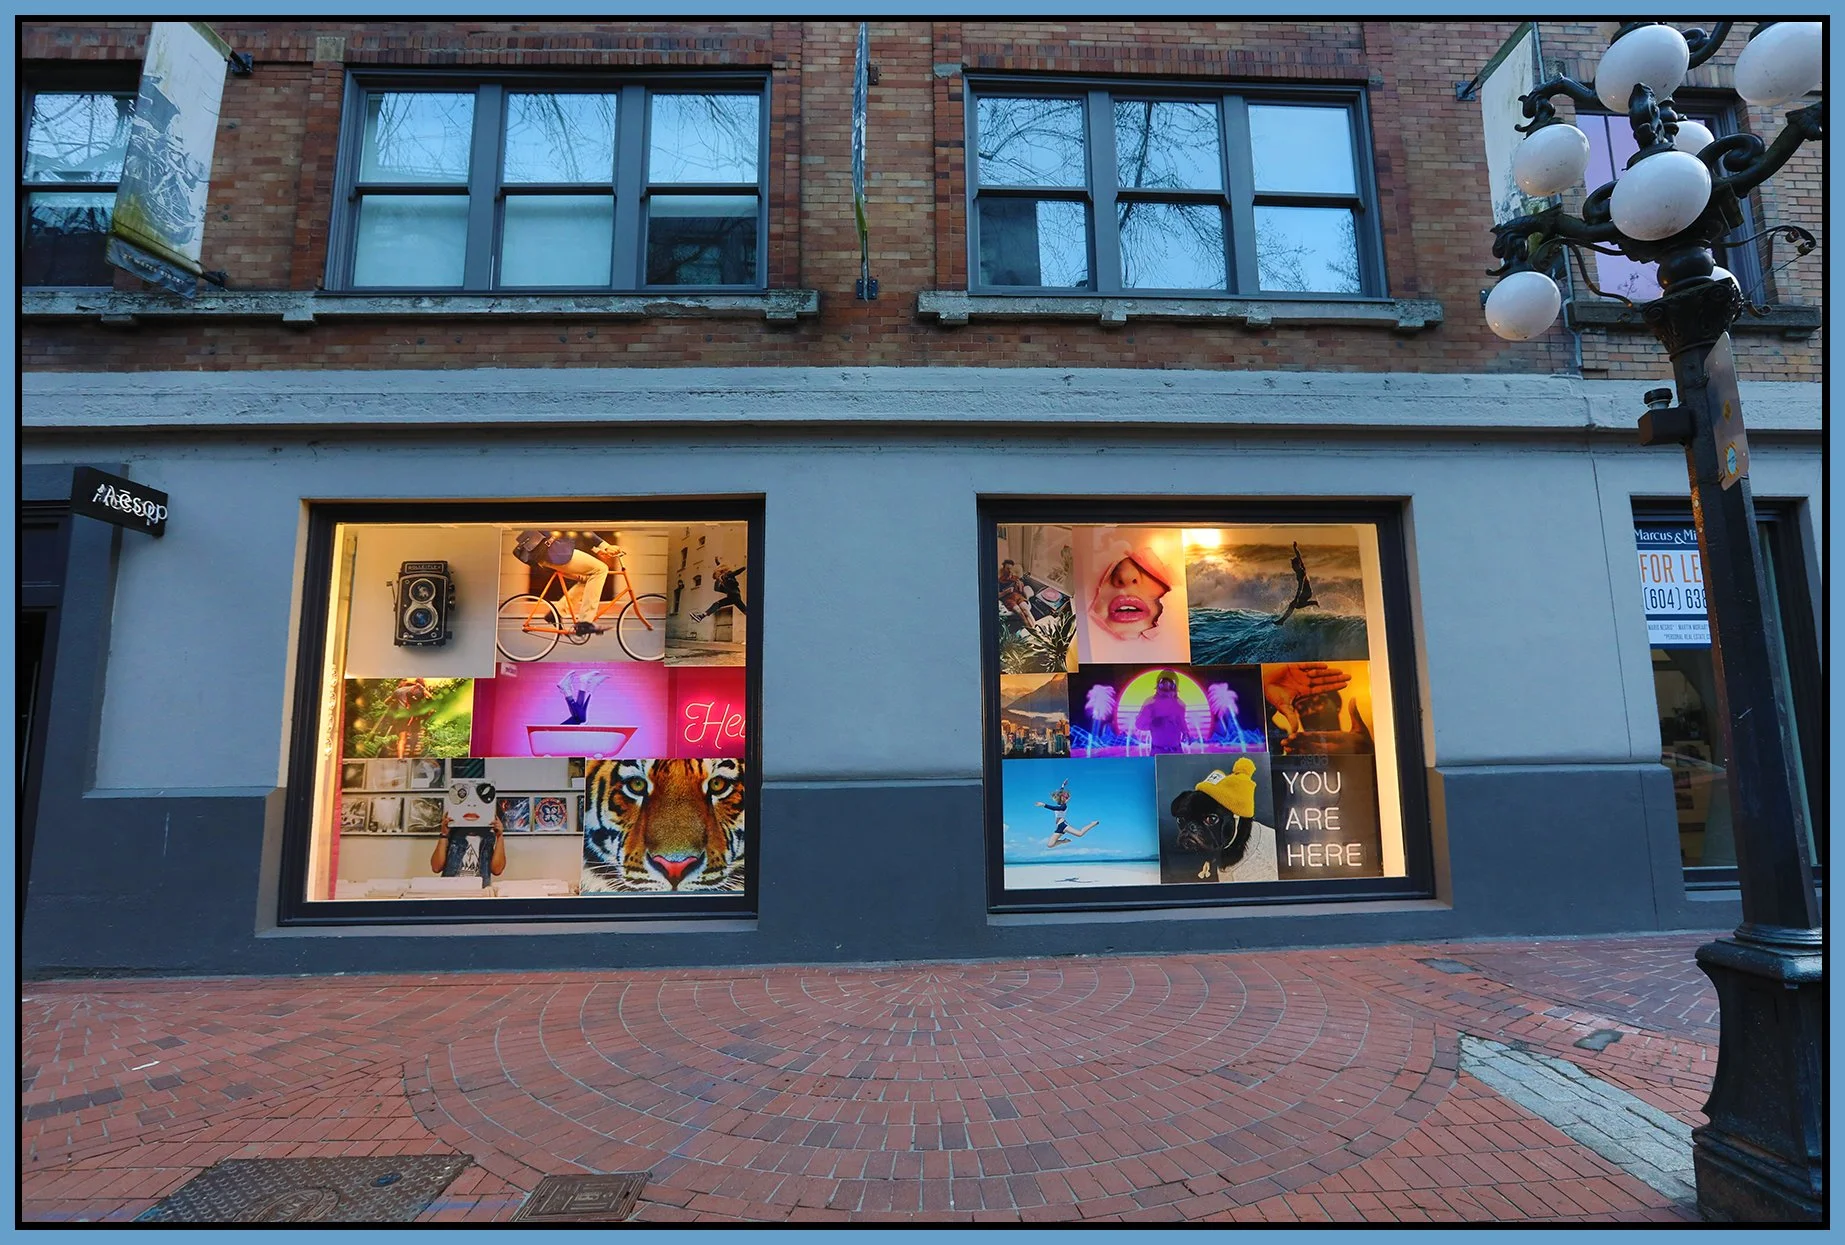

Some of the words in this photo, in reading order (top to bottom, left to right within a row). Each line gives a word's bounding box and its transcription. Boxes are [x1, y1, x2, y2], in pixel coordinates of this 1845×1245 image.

[1632, 528, 1673, 541] Marcus
[1674, 532, 1687, 544] &
[1639, 553, 1675, 584] FOR
[1643, 586, 1682, 611] (604)
[1282, 771, 1341, 795] YOU
[1285, 807, 1341, 831] ARE
[1287, 843, 1362, 867] HERE
